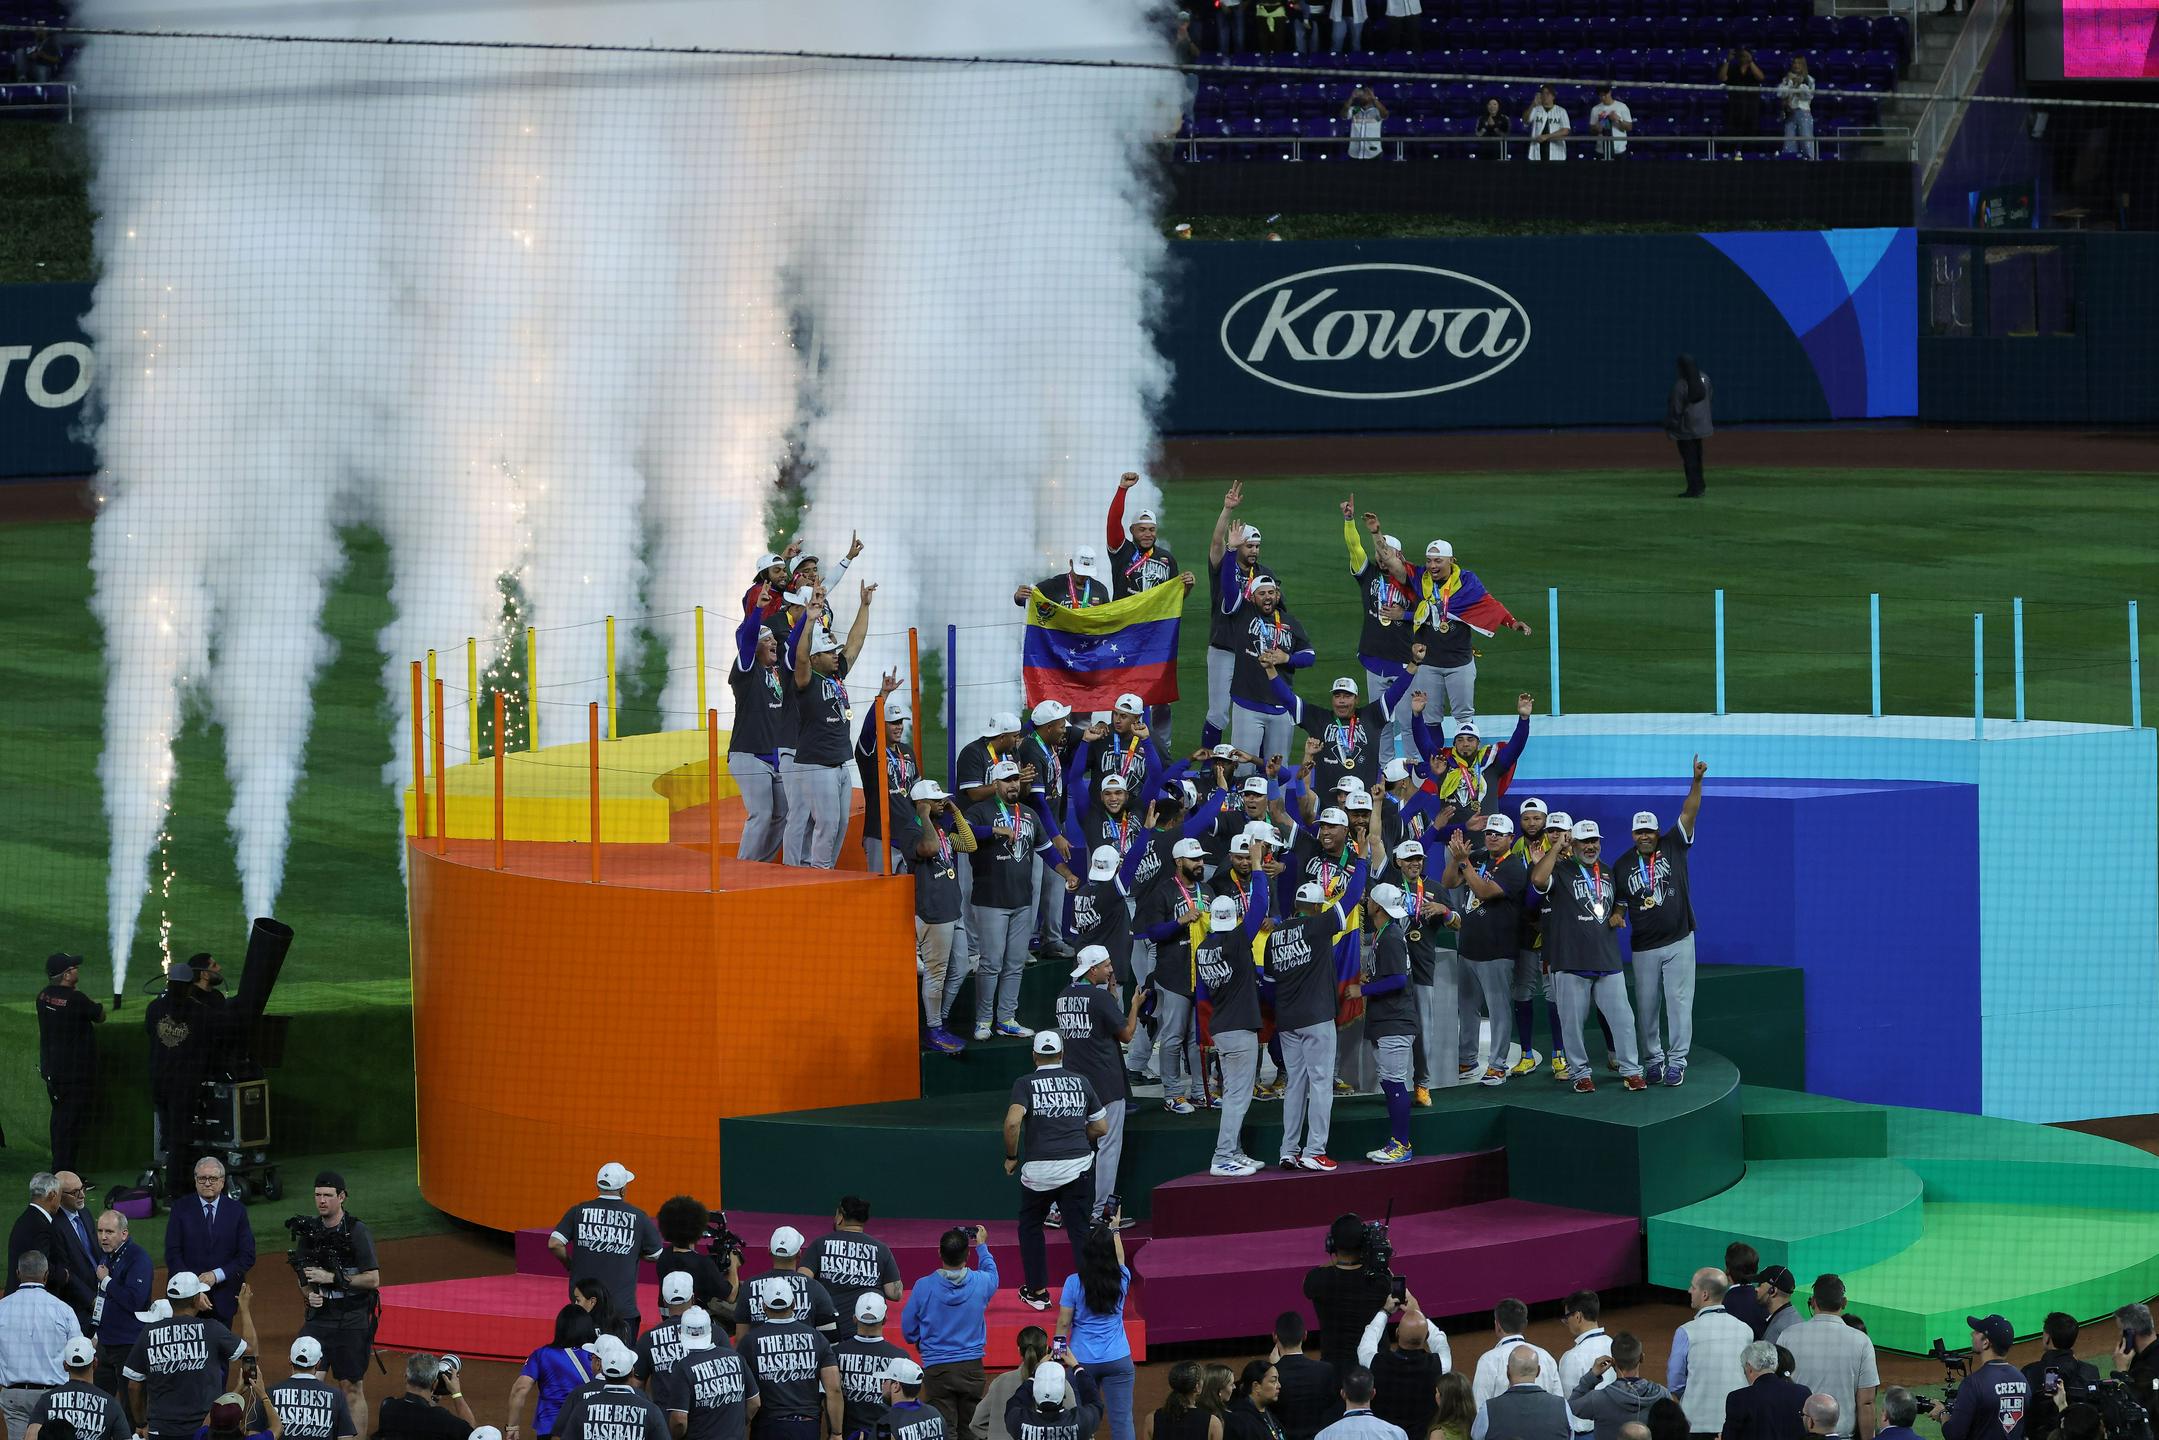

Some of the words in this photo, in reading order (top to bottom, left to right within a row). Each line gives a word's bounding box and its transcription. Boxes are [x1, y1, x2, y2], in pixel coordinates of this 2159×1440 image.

[1247, 288, 1517, 361] Kowa
[1067, 996, 1090, 1013] BEST
[1031, 1077, 1056, 1093] THE
[1055, 1076, 1083, 1092] BEST
[1032, 1091, 1087, 1109] BASEBALL
[1047, 1104, 1085, 1118] World
[581, 1207, 606, 1224] THE
[606, 1209, 637, 1229] BEST
[578, 1223, 635, 1246] BASEBALL
[589, 1239, 635, 1255] World
[824, 1239, 847, 1257] THE
[847, 1241, 879, 1261] BEST
[820, 1255, 880, 1278] BASEBALL
[831, 1271, 881, 1287] World
[148, 1325, 172, 1347] THE
[172, 1322, 205, 1342] BEST
[650, 1324, 677, 1347] THE
[757, 1334, 784, 1354] THE
[784, 1333, 815, 1352] BEST
[147, 1341, 209, 1366] BASEBALL
[757, 1351, 819, 1374] BASEBALL
[838, 1353, 863, 1373] THE
[162, 1357, 207, 1375] World
[691, 1360, 717, 1382] THE
[715, 1355, 742, 1377] BEST
[773, 1364, 819, 1384] World
[694, 1374, 745, 1401] BASEBALL
[1994, 1381, 2027, 1395] CREW
[50, 1391, 75, 1409] THE
[75, 1391, 108, 1413] BEST
[273, 1388, 299, 1406] THE
[300, 1389, 334, 1409] BEST
[2000, 1398, 2022, 1410] MLB
[587, 1403, 613, 1423] THE
[613, 1404, 648, 1425] BEST
[284, 1421, 333, 1438] World
[583, 1422, 646, 1440] BASEBALL
[898, 1422, 921, 1440] THE
[919, 1416, 943, 1439] BEST
[1020, 1422, 1045, 1440] THE
[1046, 1423, 1079, 1440] BEST
